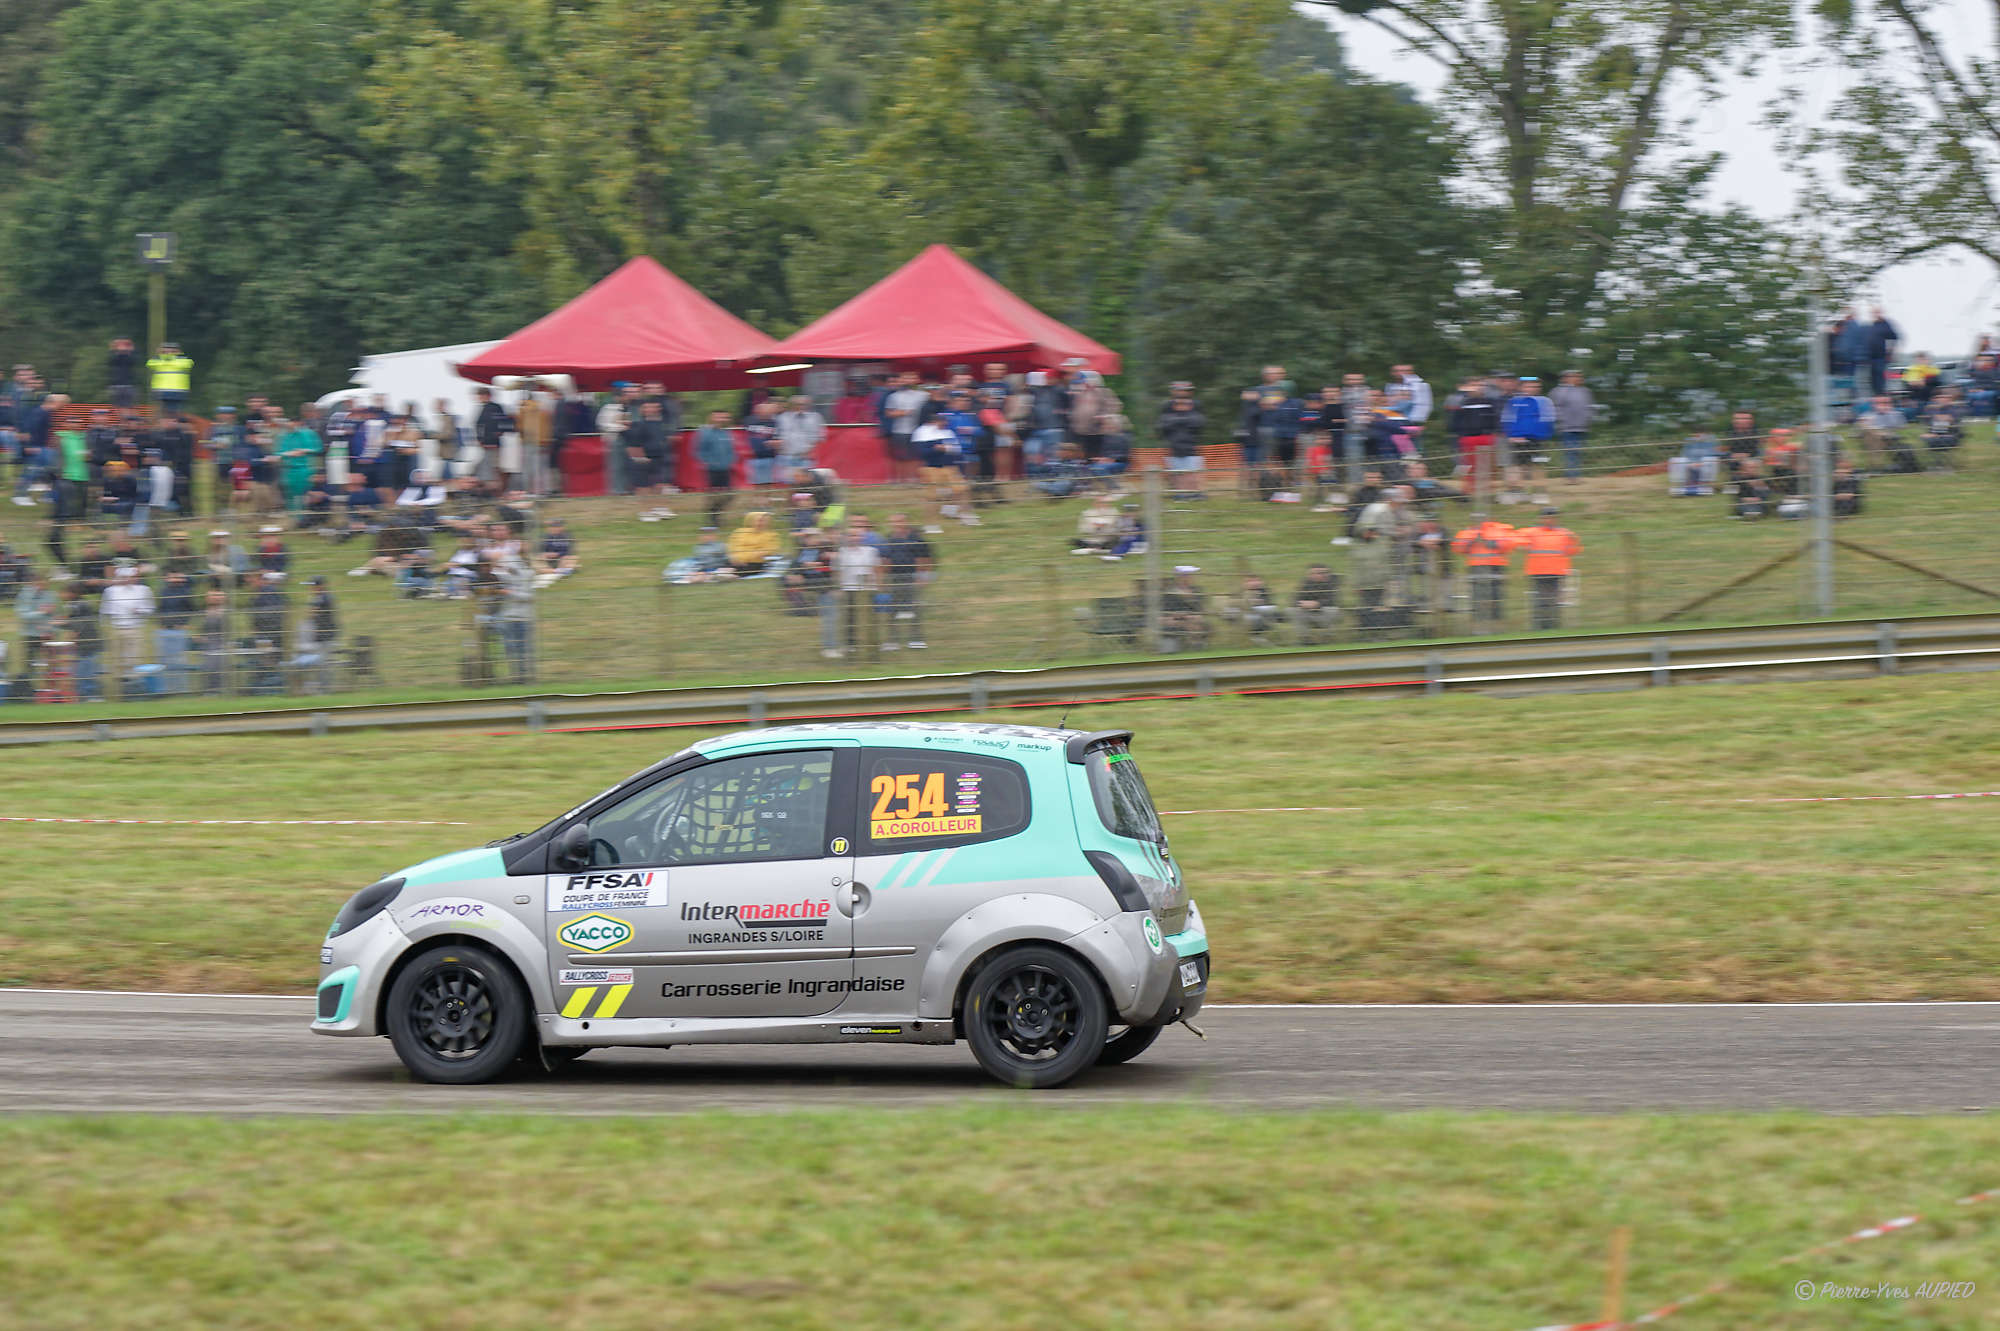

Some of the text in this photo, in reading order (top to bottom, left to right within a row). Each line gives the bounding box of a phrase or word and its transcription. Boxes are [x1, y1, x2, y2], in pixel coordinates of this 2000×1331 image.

[1017, 742, 1052, 751] markup
[870, 772, 949, 820] 254
[875, 818, 977, 835] A.COROLLEUR
[566, 873, 643, 890] FFSA
[563, 891, 649, 903] COUPE DE FRANCE
[410, 903, 485, 918] ARMOR
[567, 925, 625, 941] YACCO
[688, 929, 824, 944] INGRANDES S/LOIRE
[565, 971, 608, 981] RALLYCROSS
[661, 976, 905, 998] Carrosserie Ingrandaise
